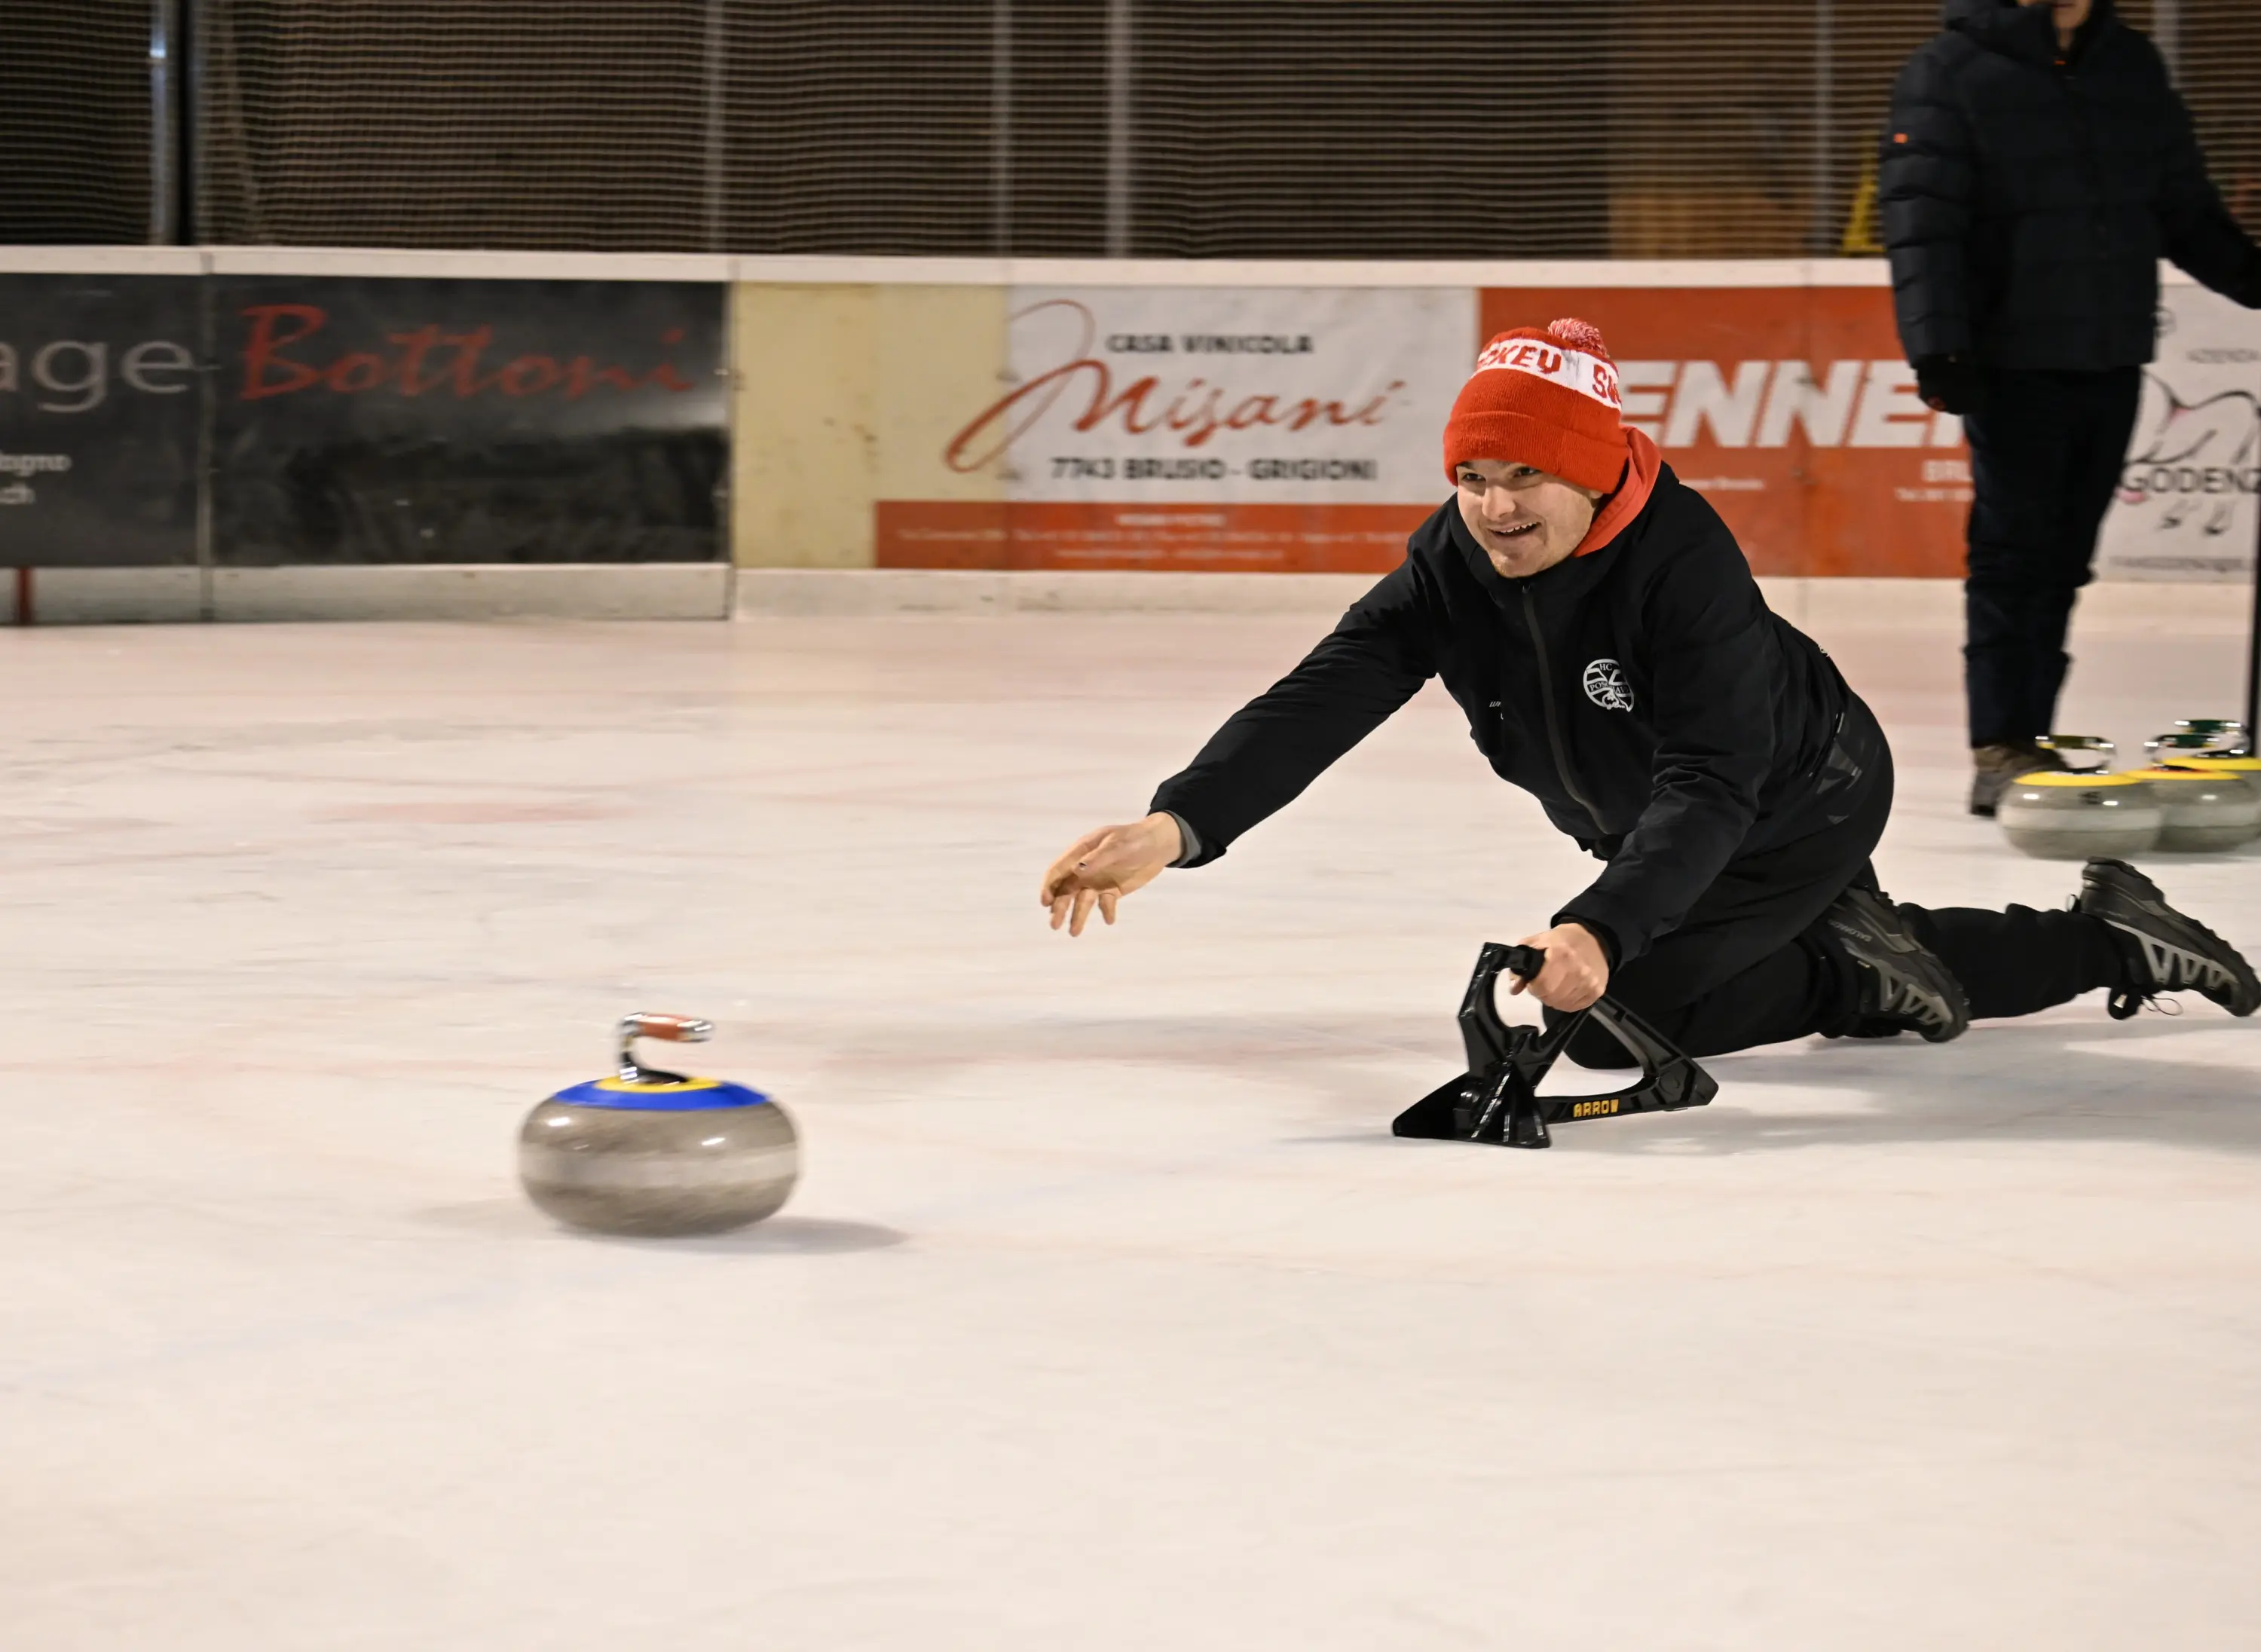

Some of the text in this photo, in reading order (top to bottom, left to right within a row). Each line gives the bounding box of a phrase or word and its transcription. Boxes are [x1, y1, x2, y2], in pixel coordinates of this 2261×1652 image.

[238, 303, 696, 401] Bottoni
[1104, 334, 1313, 355] CASA VINICOLA
[1619, 359, 1964, 448] ENNE
[1051, 457, 1113, 480] 7743
[1124, 457, 1224, 480] BRUSIO
[1248, 457, 1378, 481] GRIGIONI
[1573, 1099, 1619, 1118] ARROW
